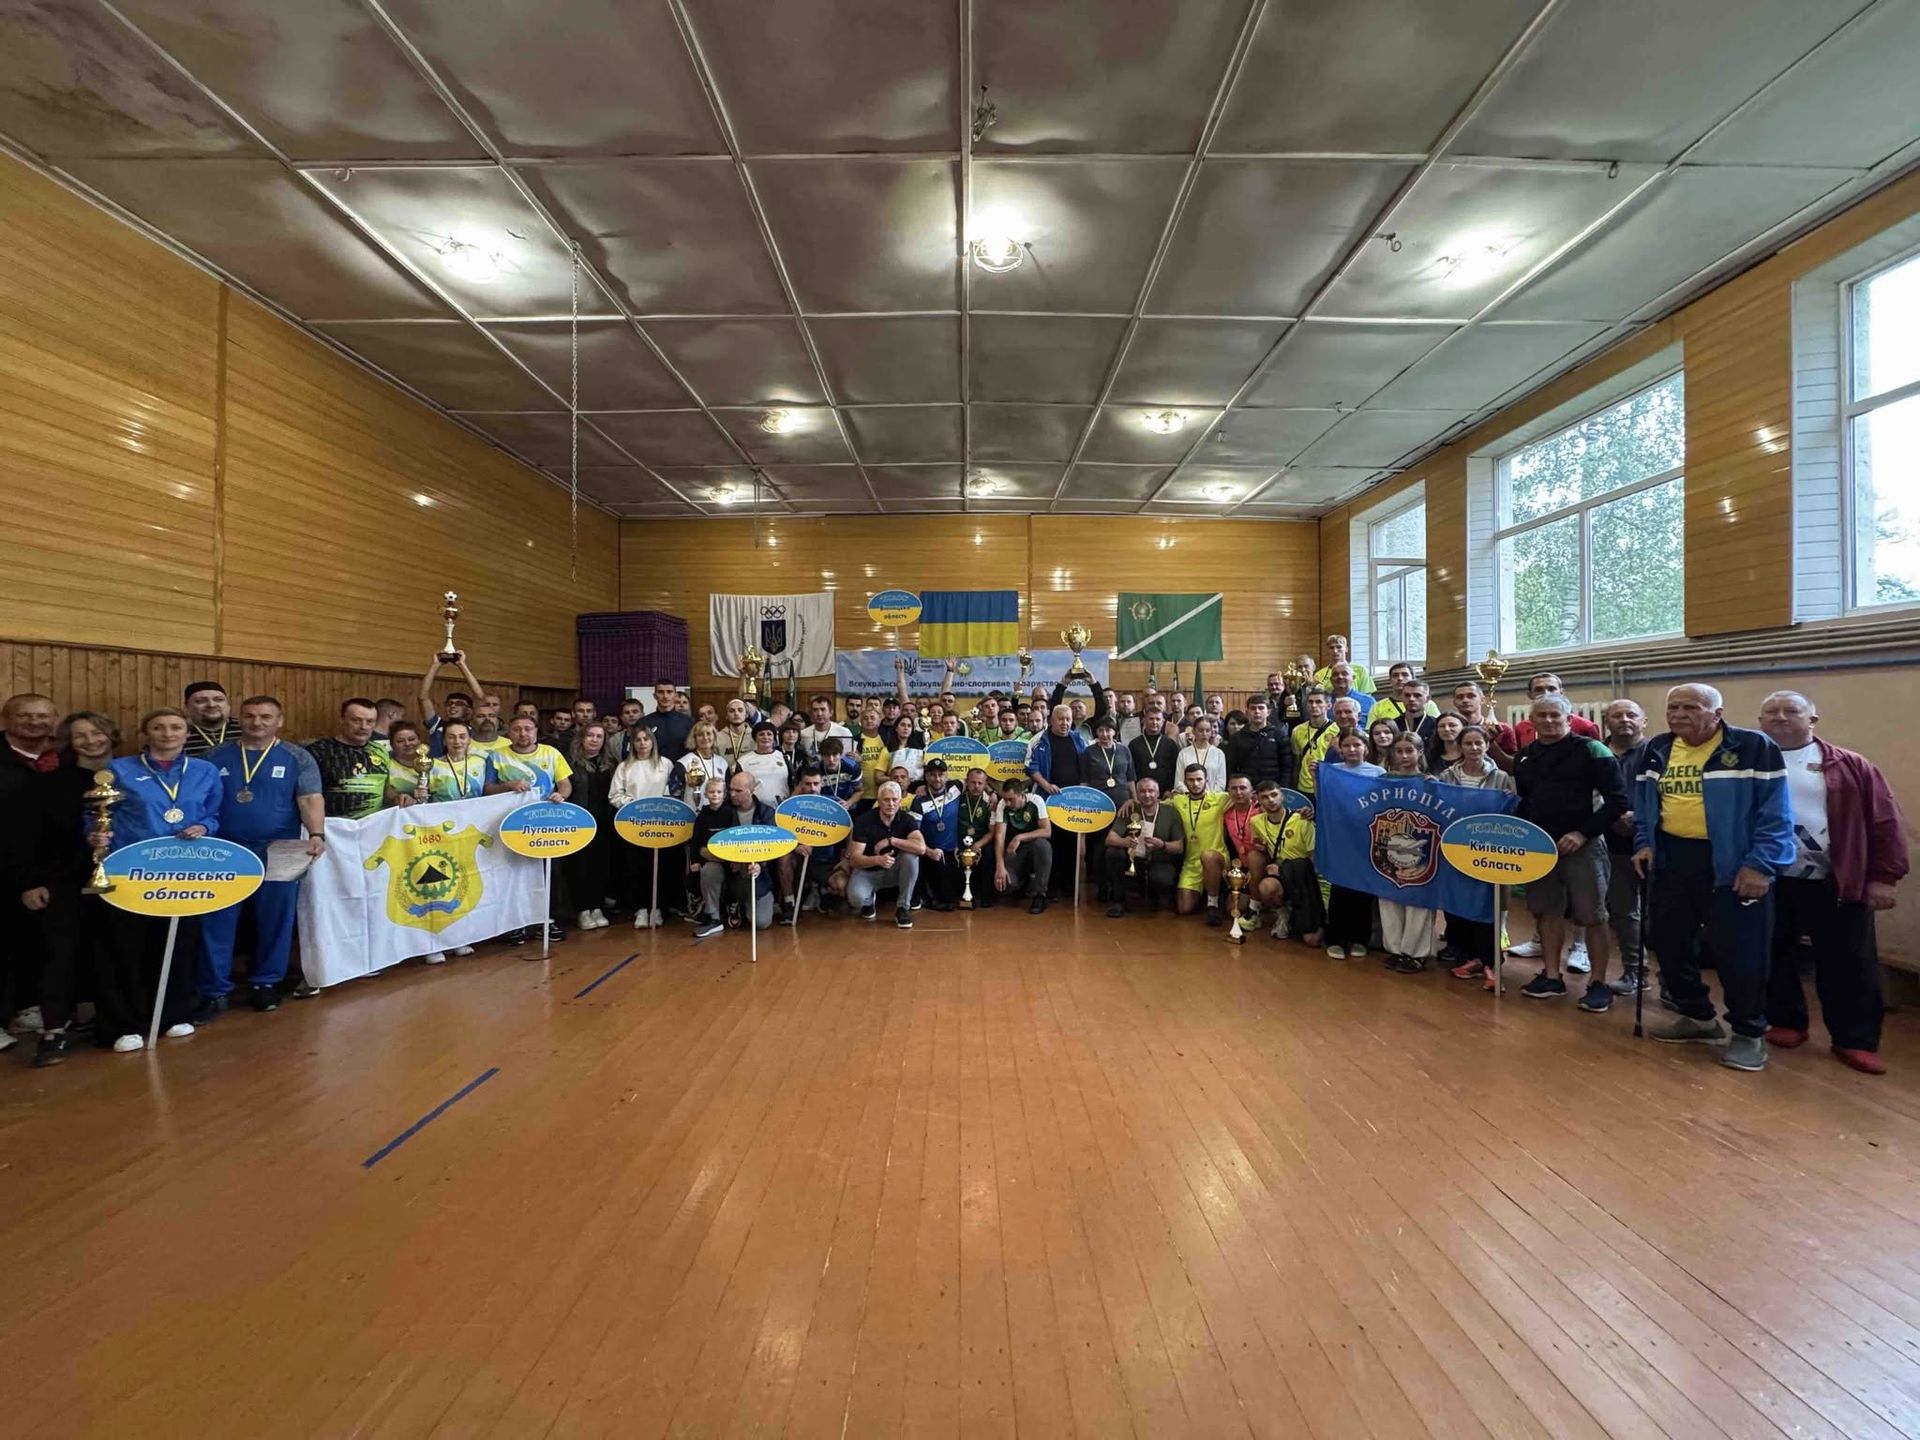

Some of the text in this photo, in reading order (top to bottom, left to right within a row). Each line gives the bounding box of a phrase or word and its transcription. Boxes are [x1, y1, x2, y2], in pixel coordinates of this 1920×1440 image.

[848, 679, 898, 688] Всеукраїнсь
[949, 764, 970, 772] бласт
[1664, 765, 1701, 779] ДЕСЬ
[1357, 787, 1456, 819] БОРИСПІЛ
[629, 816, 686, 827] Чернігівська
[791, 812, 837, 827] Рівненська
[522, 825, 577, 836] Луганська
[639, 830, 675, 838] область
[795, 826, 828, 837] область
[419, 834, 442, 845] 1680
[529, 838, 570, 848] область
[1470, 840, 1526, 856] Київська
[1472, 857, 1522, 872] область
[128, 868, 236, 881] Полтавська
[143, 887, 215, 900] область
